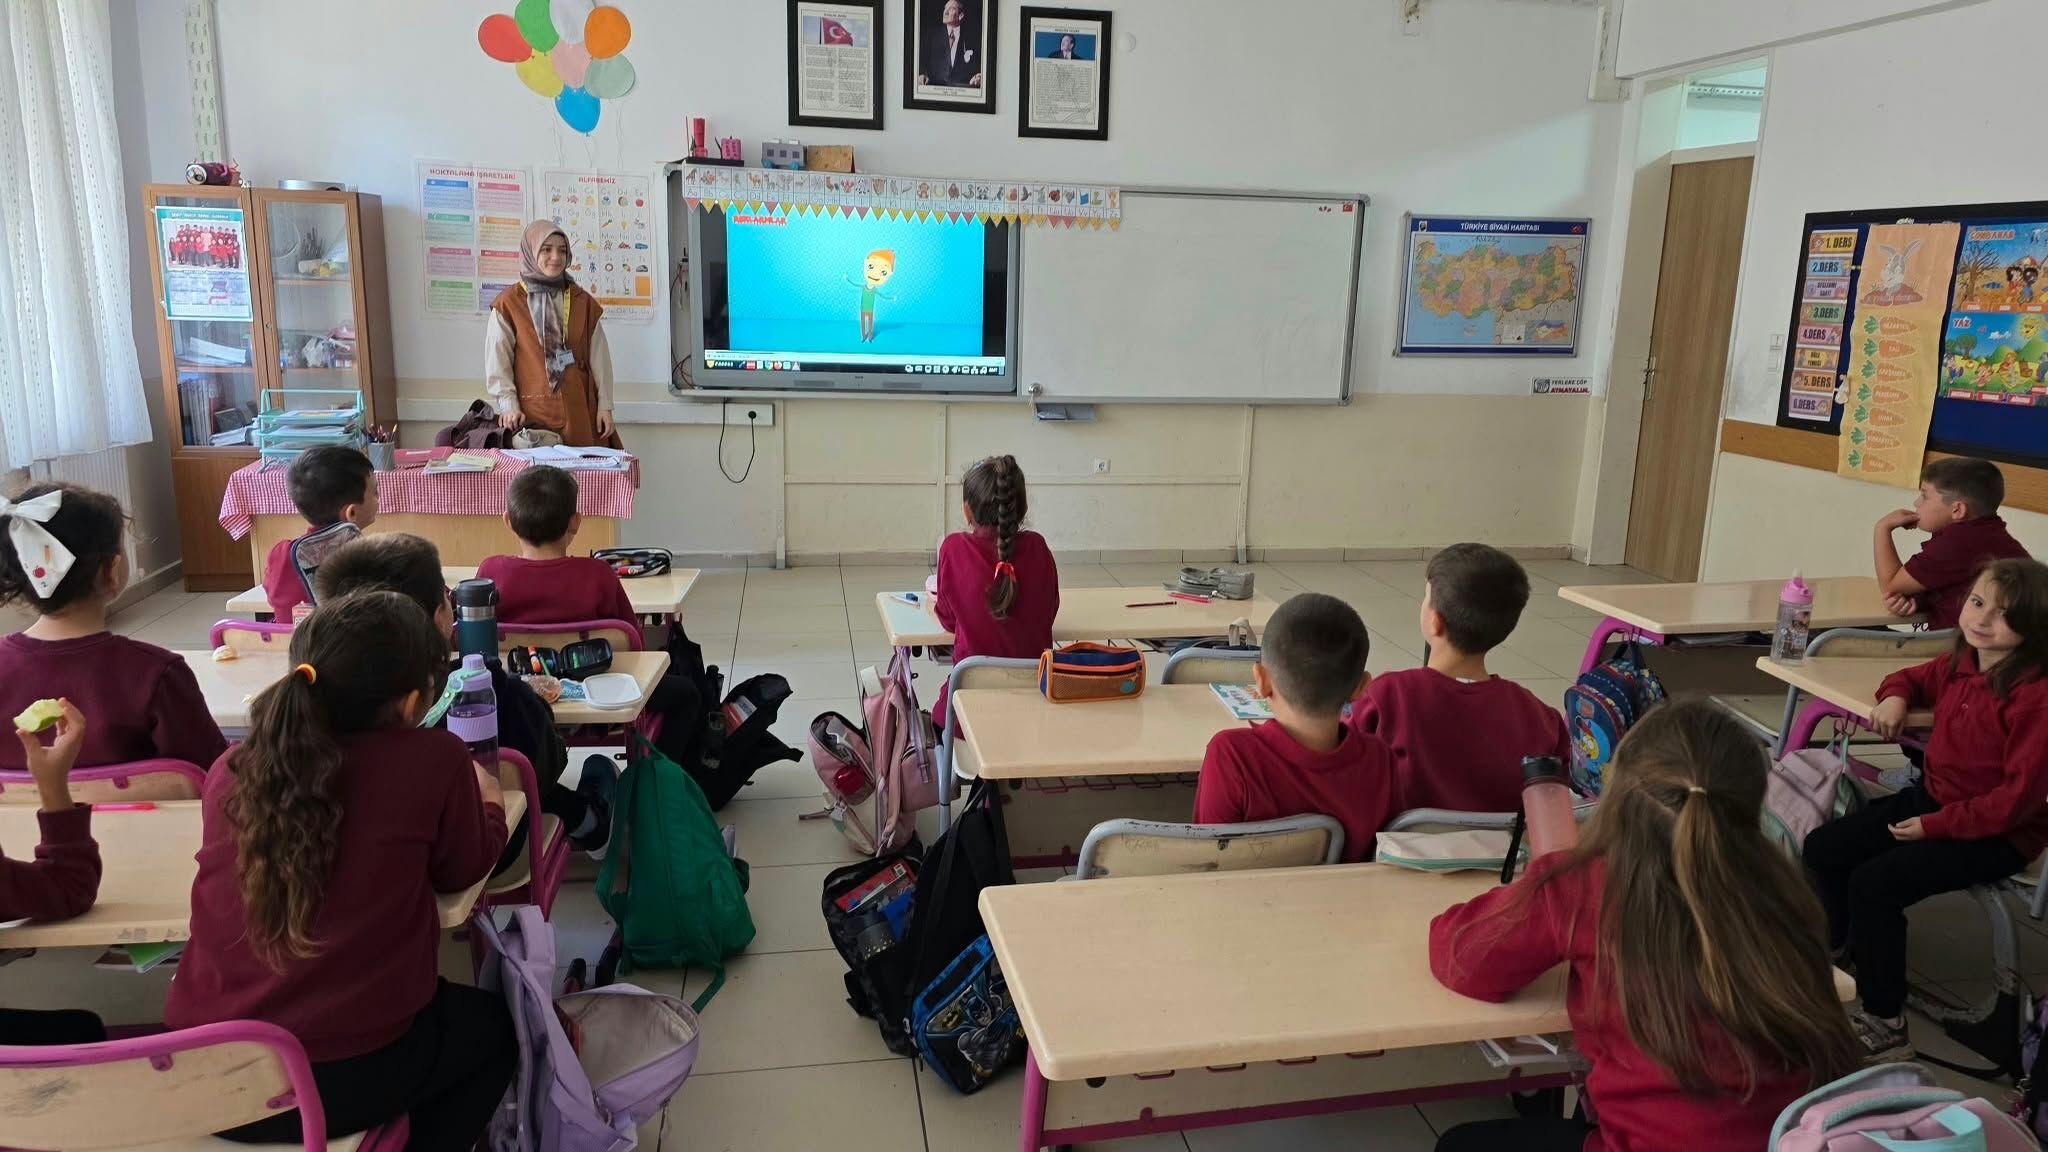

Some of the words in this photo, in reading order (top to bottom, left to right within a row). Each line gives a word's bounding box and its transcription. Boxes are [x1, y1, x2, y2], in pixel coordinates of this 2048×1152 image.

[1461, 222, 1489, 231] TÜRKİYE
[1489, 223, 1510, 231] SİYASİ
[1511, 224, 1540, 232] HARİTASI
[1833, 237, 1852, 248] DERS
[1812, 262, 1839, 273] 2.DERS
[1813, 307, 1839, 319] 3.DERS
[1953, 318, 1971, 328] YAZ
[1803, 328, 1826, 340] 4.DERS
[1811, 376, 1831, 387] DERS
